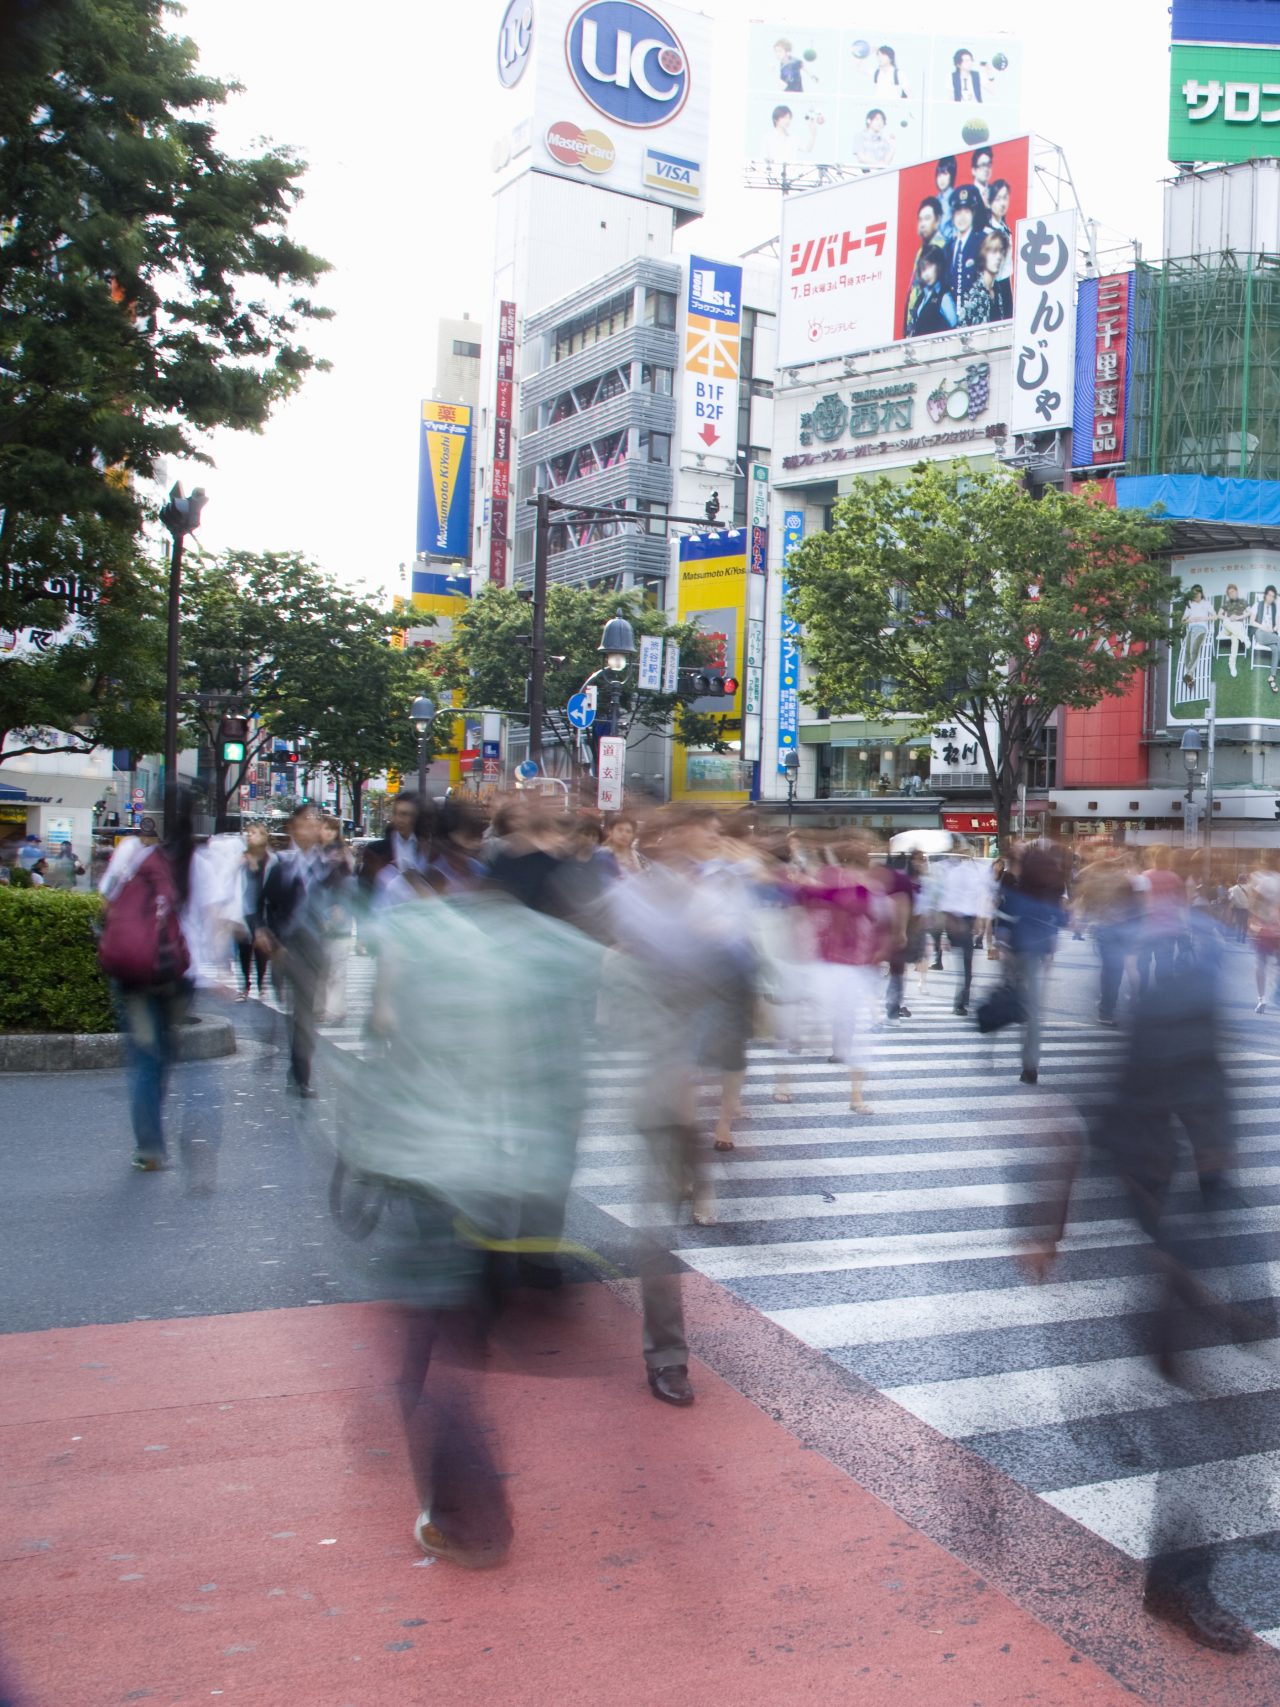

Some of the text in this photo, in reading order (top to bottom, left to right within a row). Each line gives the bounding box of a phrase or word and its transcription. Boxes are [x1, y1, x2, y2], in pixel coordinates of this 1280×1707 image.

[582, 18, 684, 101] UC
[547, 132, 615, 161] MasterCard
[655, 161, 691, 184] VISA
[790, 221, 888, 277] シバトラ
[686, 319, 740, 378] 本
[1017, 219, 1070, 422] もんじゃ
[696, 382, 724, 400] B1F
[1093, 279, 1121, 453] 三千里薬品
[696, 402, 724, 420] B2F
[436, 479, 451, 549] Matsumoto
[683, 569, 723, 581] Matsumoto
[601, 744, 615, 802] 道玄坂
